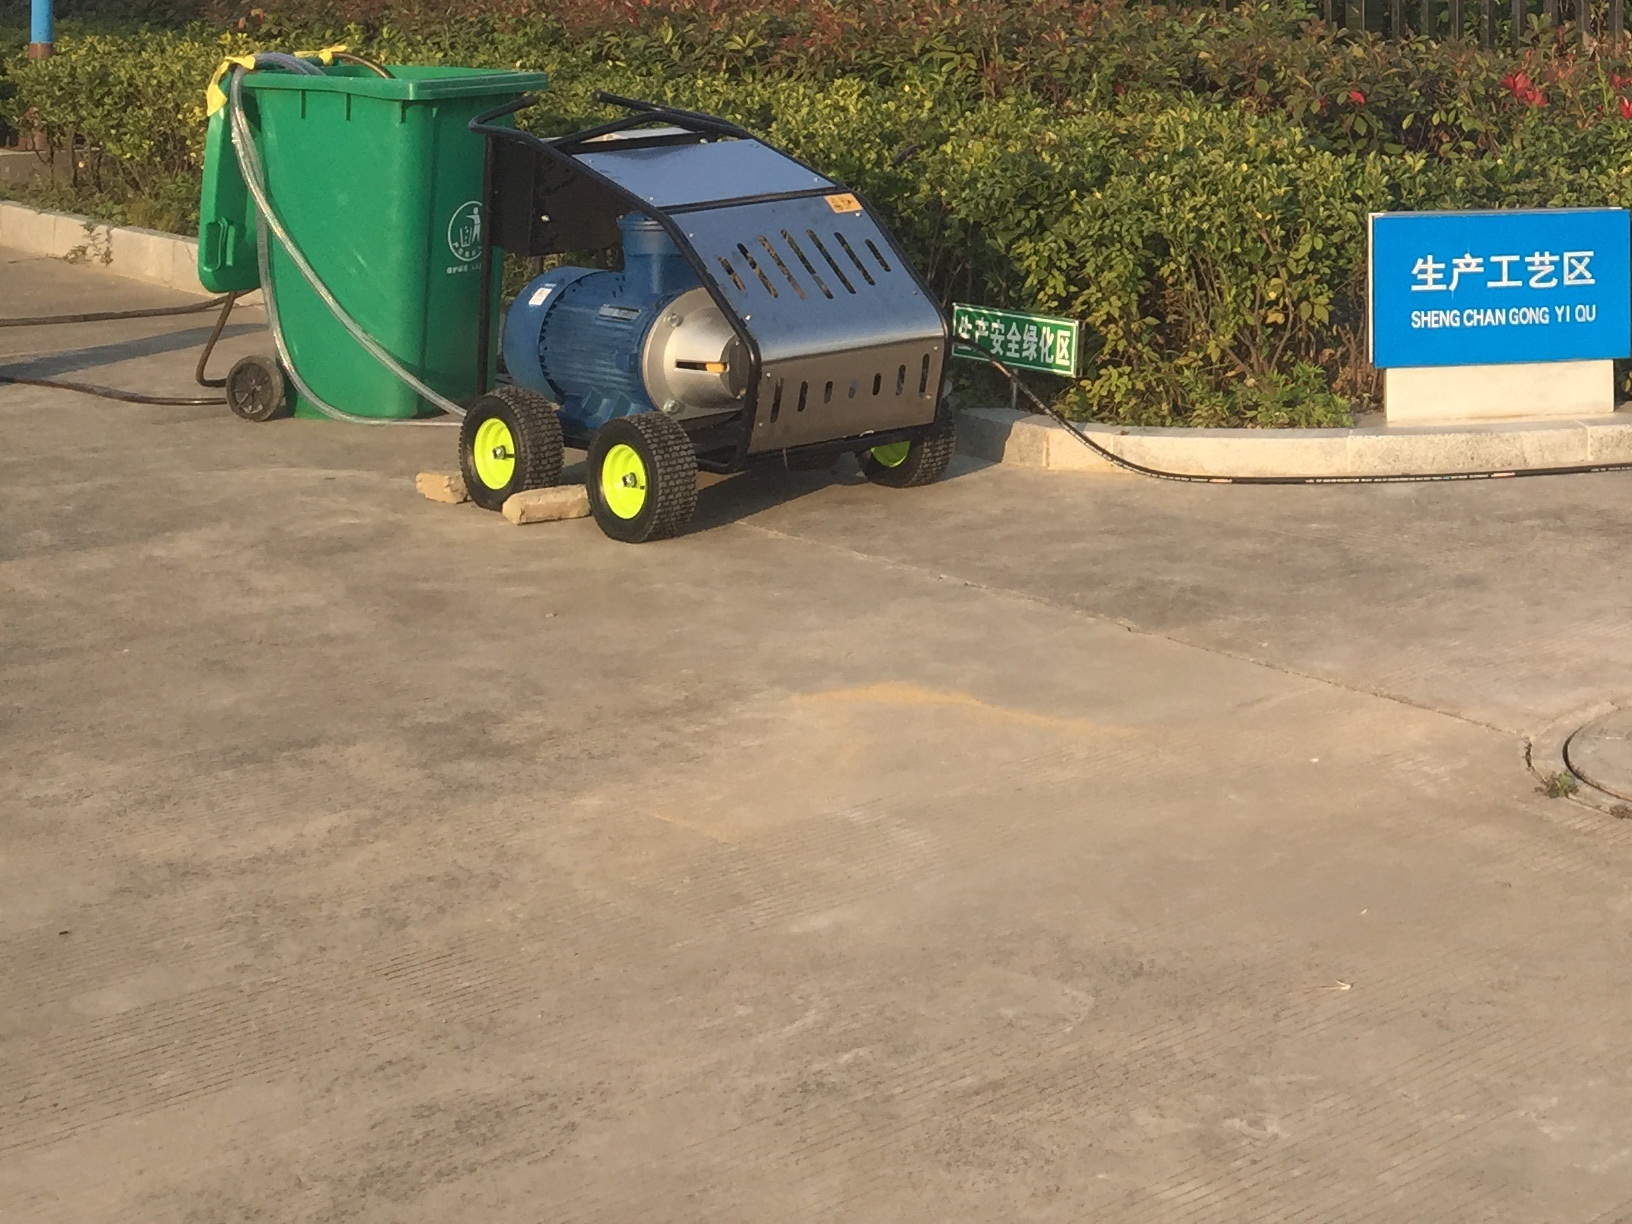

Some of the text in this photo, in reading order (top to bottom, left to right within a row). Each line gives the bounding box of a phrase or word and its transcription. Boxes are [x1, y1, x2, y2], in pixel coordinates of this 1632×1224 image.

[1411, 250, 1596, 291] 生产工艺区
[1411, 304, 1596, 328] SHENG CHAN GONG YI QU
[957, 314, 1071, 366] 生产安全绿化区
